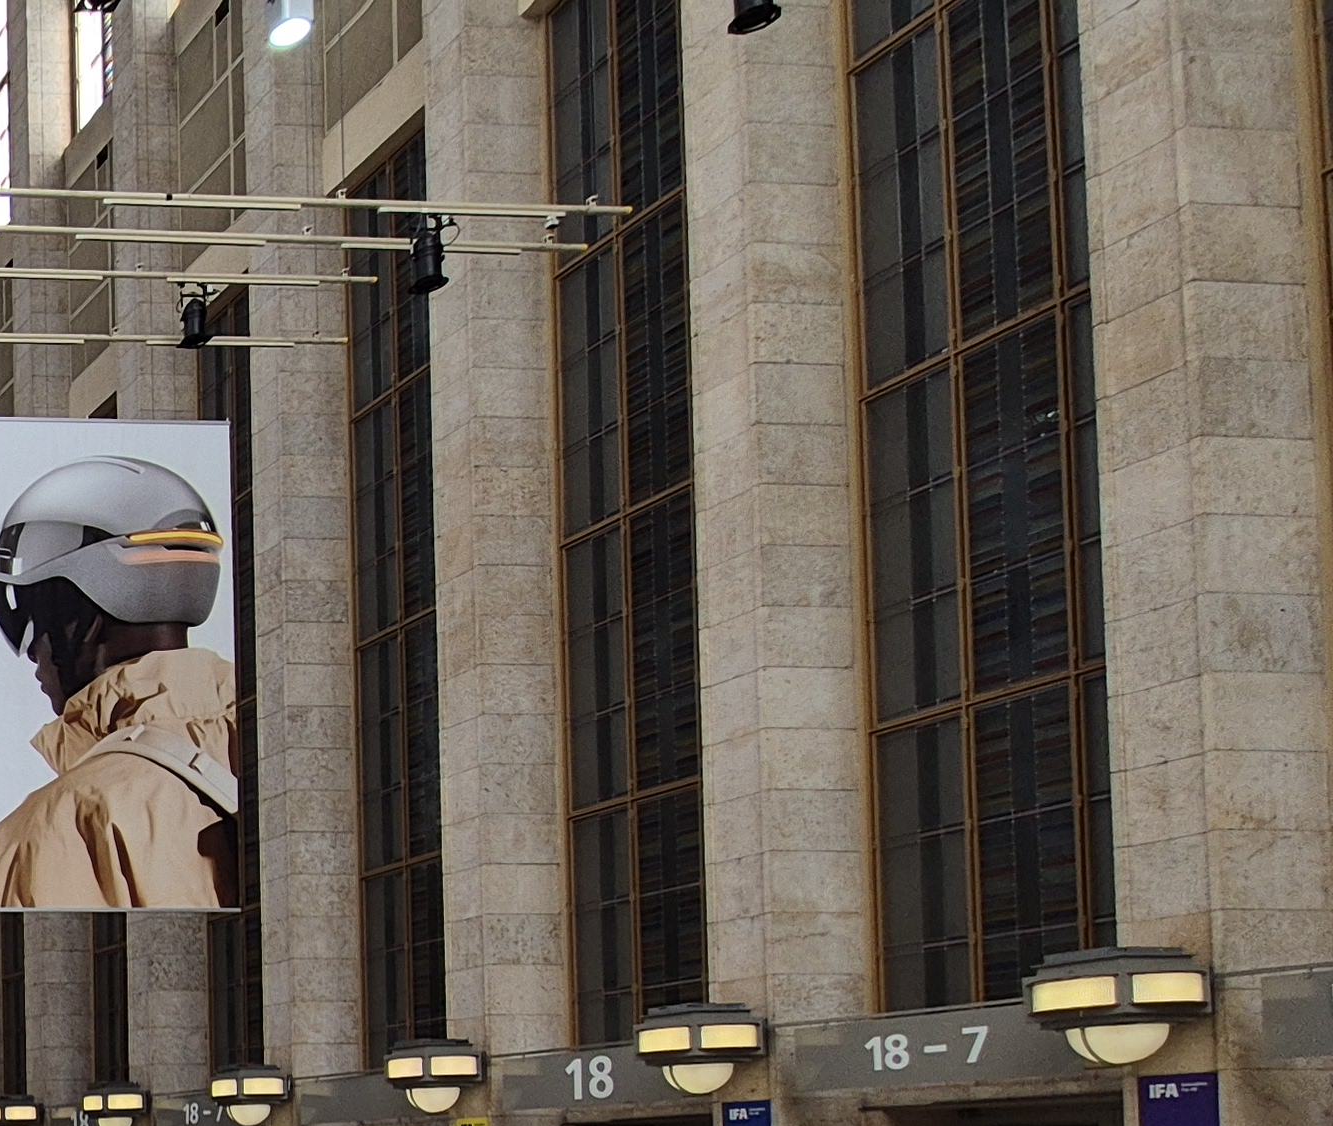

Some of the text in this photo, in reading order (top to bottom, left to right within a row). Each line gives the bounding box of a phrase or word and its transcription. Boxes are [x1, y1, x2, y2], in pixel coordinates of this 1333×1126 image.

[864, 1033, 910, 1071] 18
[961, 1026, 988, 1064] 7
[565, 1055, 613, 1100] 18
[1149, 1083, 1179, 1099] IFA
[184, 1102, 199, 1125] 18
[729, 1108, 748, 1120] IFA
